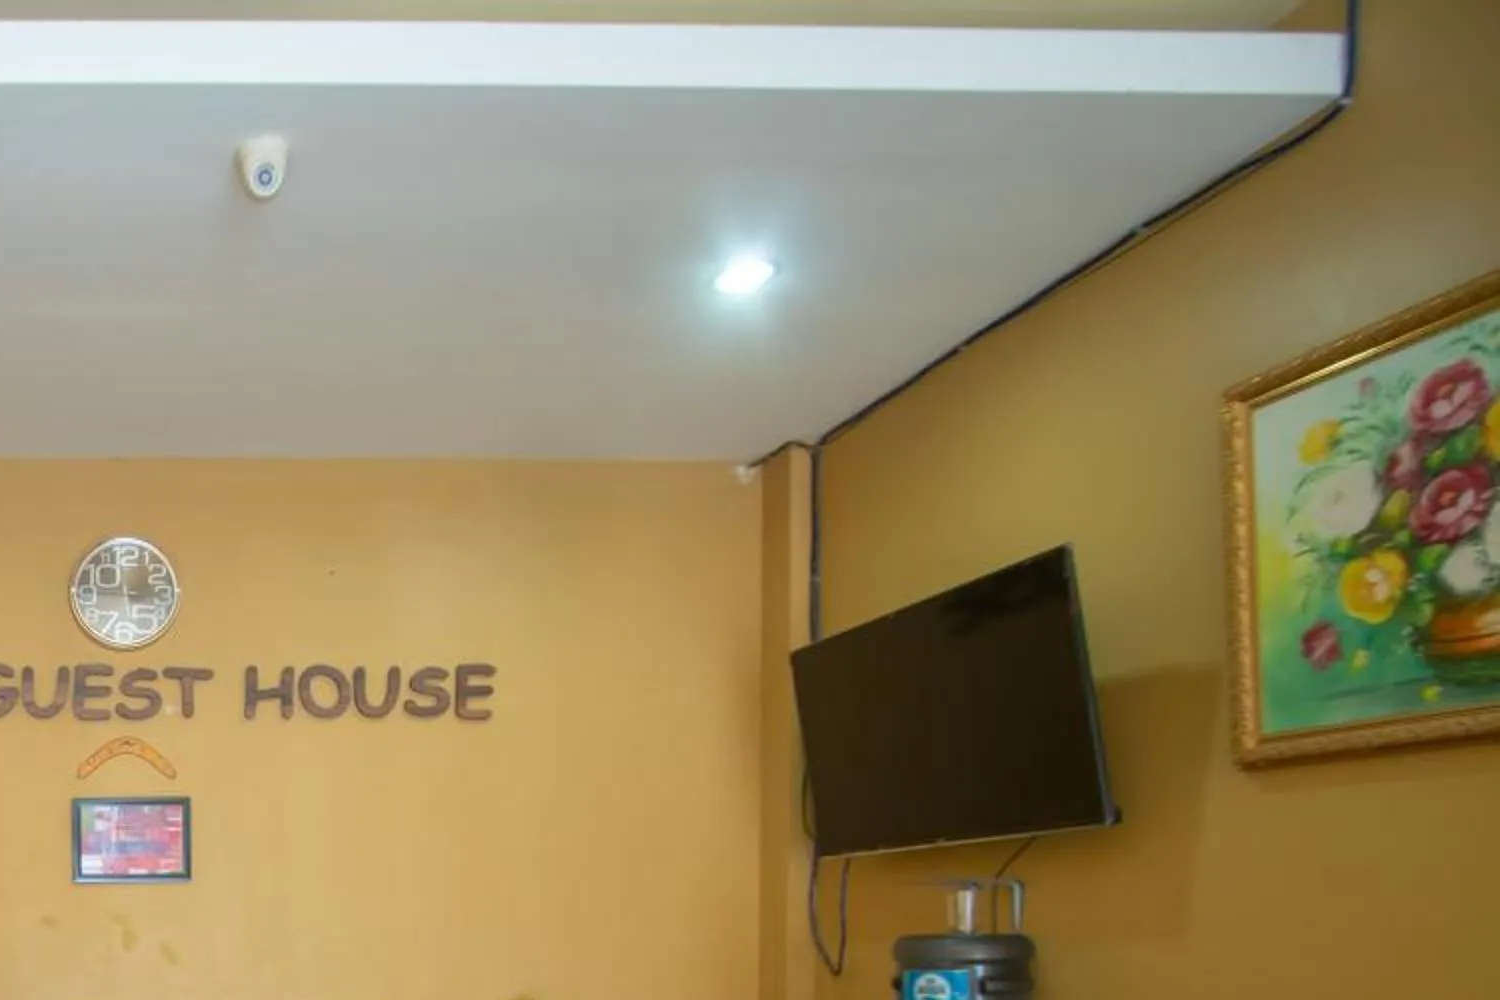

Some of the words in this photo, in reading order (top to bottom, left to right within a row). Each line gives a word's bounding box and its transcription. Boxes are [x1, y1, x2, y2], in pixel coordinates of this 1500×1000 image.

[113, 545, 139, 567] 12
[142, 551, 150, 566] 1
[83, 563, 121, 588] 10
[147, 563, 167, 585] 2
[80, 584, 97, 605] 9
[154, 585, 173, 606] 3
[98, 610, 119, 634] 7
[132, 604, 158, 635] 5
[114, 620, 135, 643] 6
[243, 663, 497, 721] HOUSE
